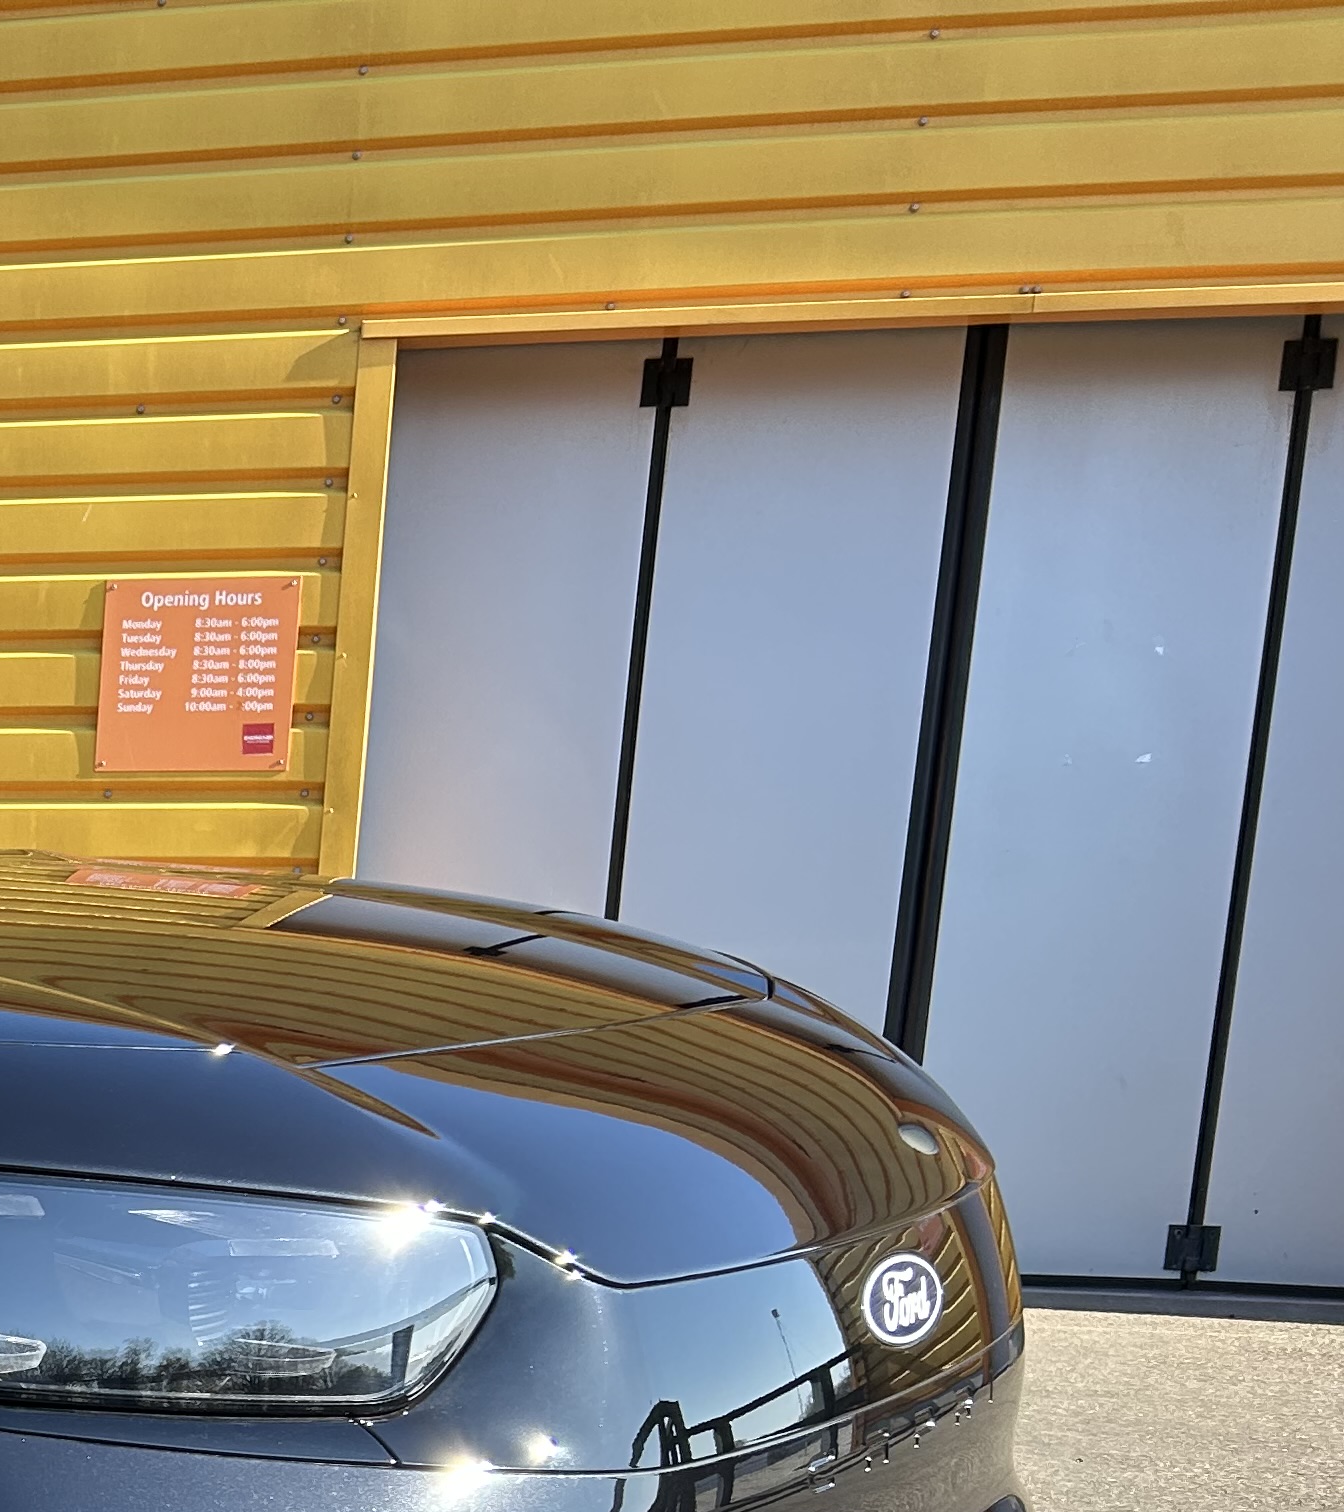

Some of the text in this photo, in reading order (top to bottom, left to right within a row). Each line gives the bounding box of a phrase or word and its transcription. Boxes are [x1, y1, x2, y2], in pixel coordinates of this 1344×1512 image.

[141, 590, 263, 611] Opening Hours
[122, 618, 162, 631] Monday
[241, 616, 279, 629] 6:00pm
[121, 633, 162, 645] Tuesday
[240, 630, 278, 643] 6:00pm
[120, 645, 177, 659] Wednesday
[239, 645, 277, 657] 6:00pm
[120, 660, 165, 673] Thursday
[118, 673, 150, 687] Friday
[237, 673, 275, 685] 6:00pm
[117, 688, 162, 700] Saturday
[236, 687, 274, 699] 4:00pm
[116, 701, 154, 714] Sunday
[185, 701, 226, 712] 10:00am
[237, 701, 274, 713] :00pm
[882, 1266, 931, 1332] Ford
